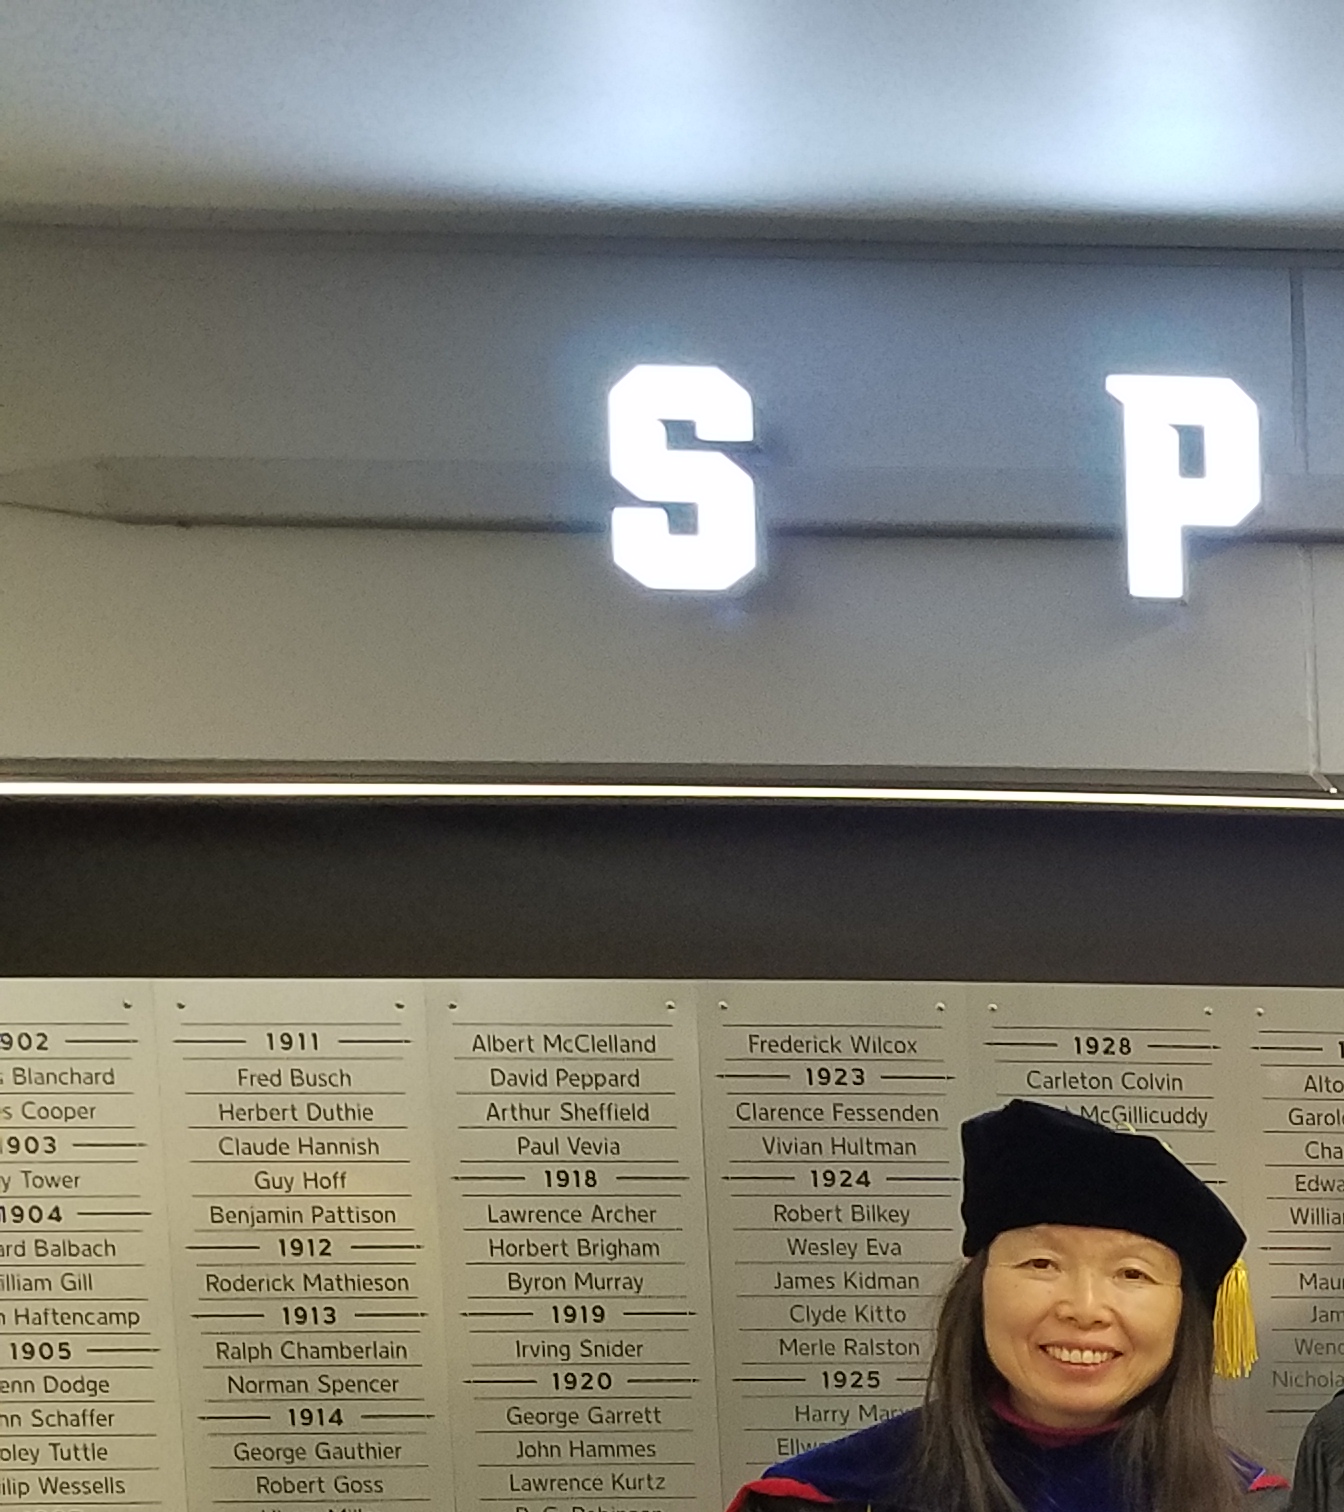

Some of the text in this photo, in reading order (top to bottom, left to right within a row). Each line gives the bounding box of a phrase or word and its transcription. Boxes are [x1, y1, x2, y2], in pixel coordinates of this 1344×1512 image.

[266, 1032, 318, 1051] 1911
[471, 1033, 657, 1054] Albert McClelland
[748, 1033, 918, 1055] Frederick Wilcox
[1074, 1036, 1132, 1056] 1928
[237, 1067, 352, 1088] Fred Busch
[490, 1067, 640, 1091] David Peppard
[806, 1066, 865, 1087] 1923
[1026, 1069, 1184, 1092] Carleton Colvin
[218, 1102, 374, 1122] Herbert Duthie
[517, 1135, 621, 1156] Paul Vevia
[254, 1170, 347, 1194] Guy Hoff
[544, 1169, 598, 1188] 1918
[810, 1169, 871, 1188] 1924
[209, 1205, 397, 1228] Benjamin Pattison
[487, 1203, 657, 1224] Lawrence Archer
[773, 1203, 910, 1227] Robert Bilkey
[278, 1237, 332, 1257] 1912
[773, 1270, 920, 1290] James Kidman
[551, 1304, 606, 1324] 1919
[10, 1341, 72, 1361] 1905
[215, 1340, 408, 1364] Ralph Chamberlain
[552, 1371, 612, 1391] 1920
[822, 1370, 881, 1389] 1925
[288, 1407, 344, 1427] 1914
[515, 1439, 657, 1459] John Hammes
[256, 1474, 384, 1495] Robert Goss
